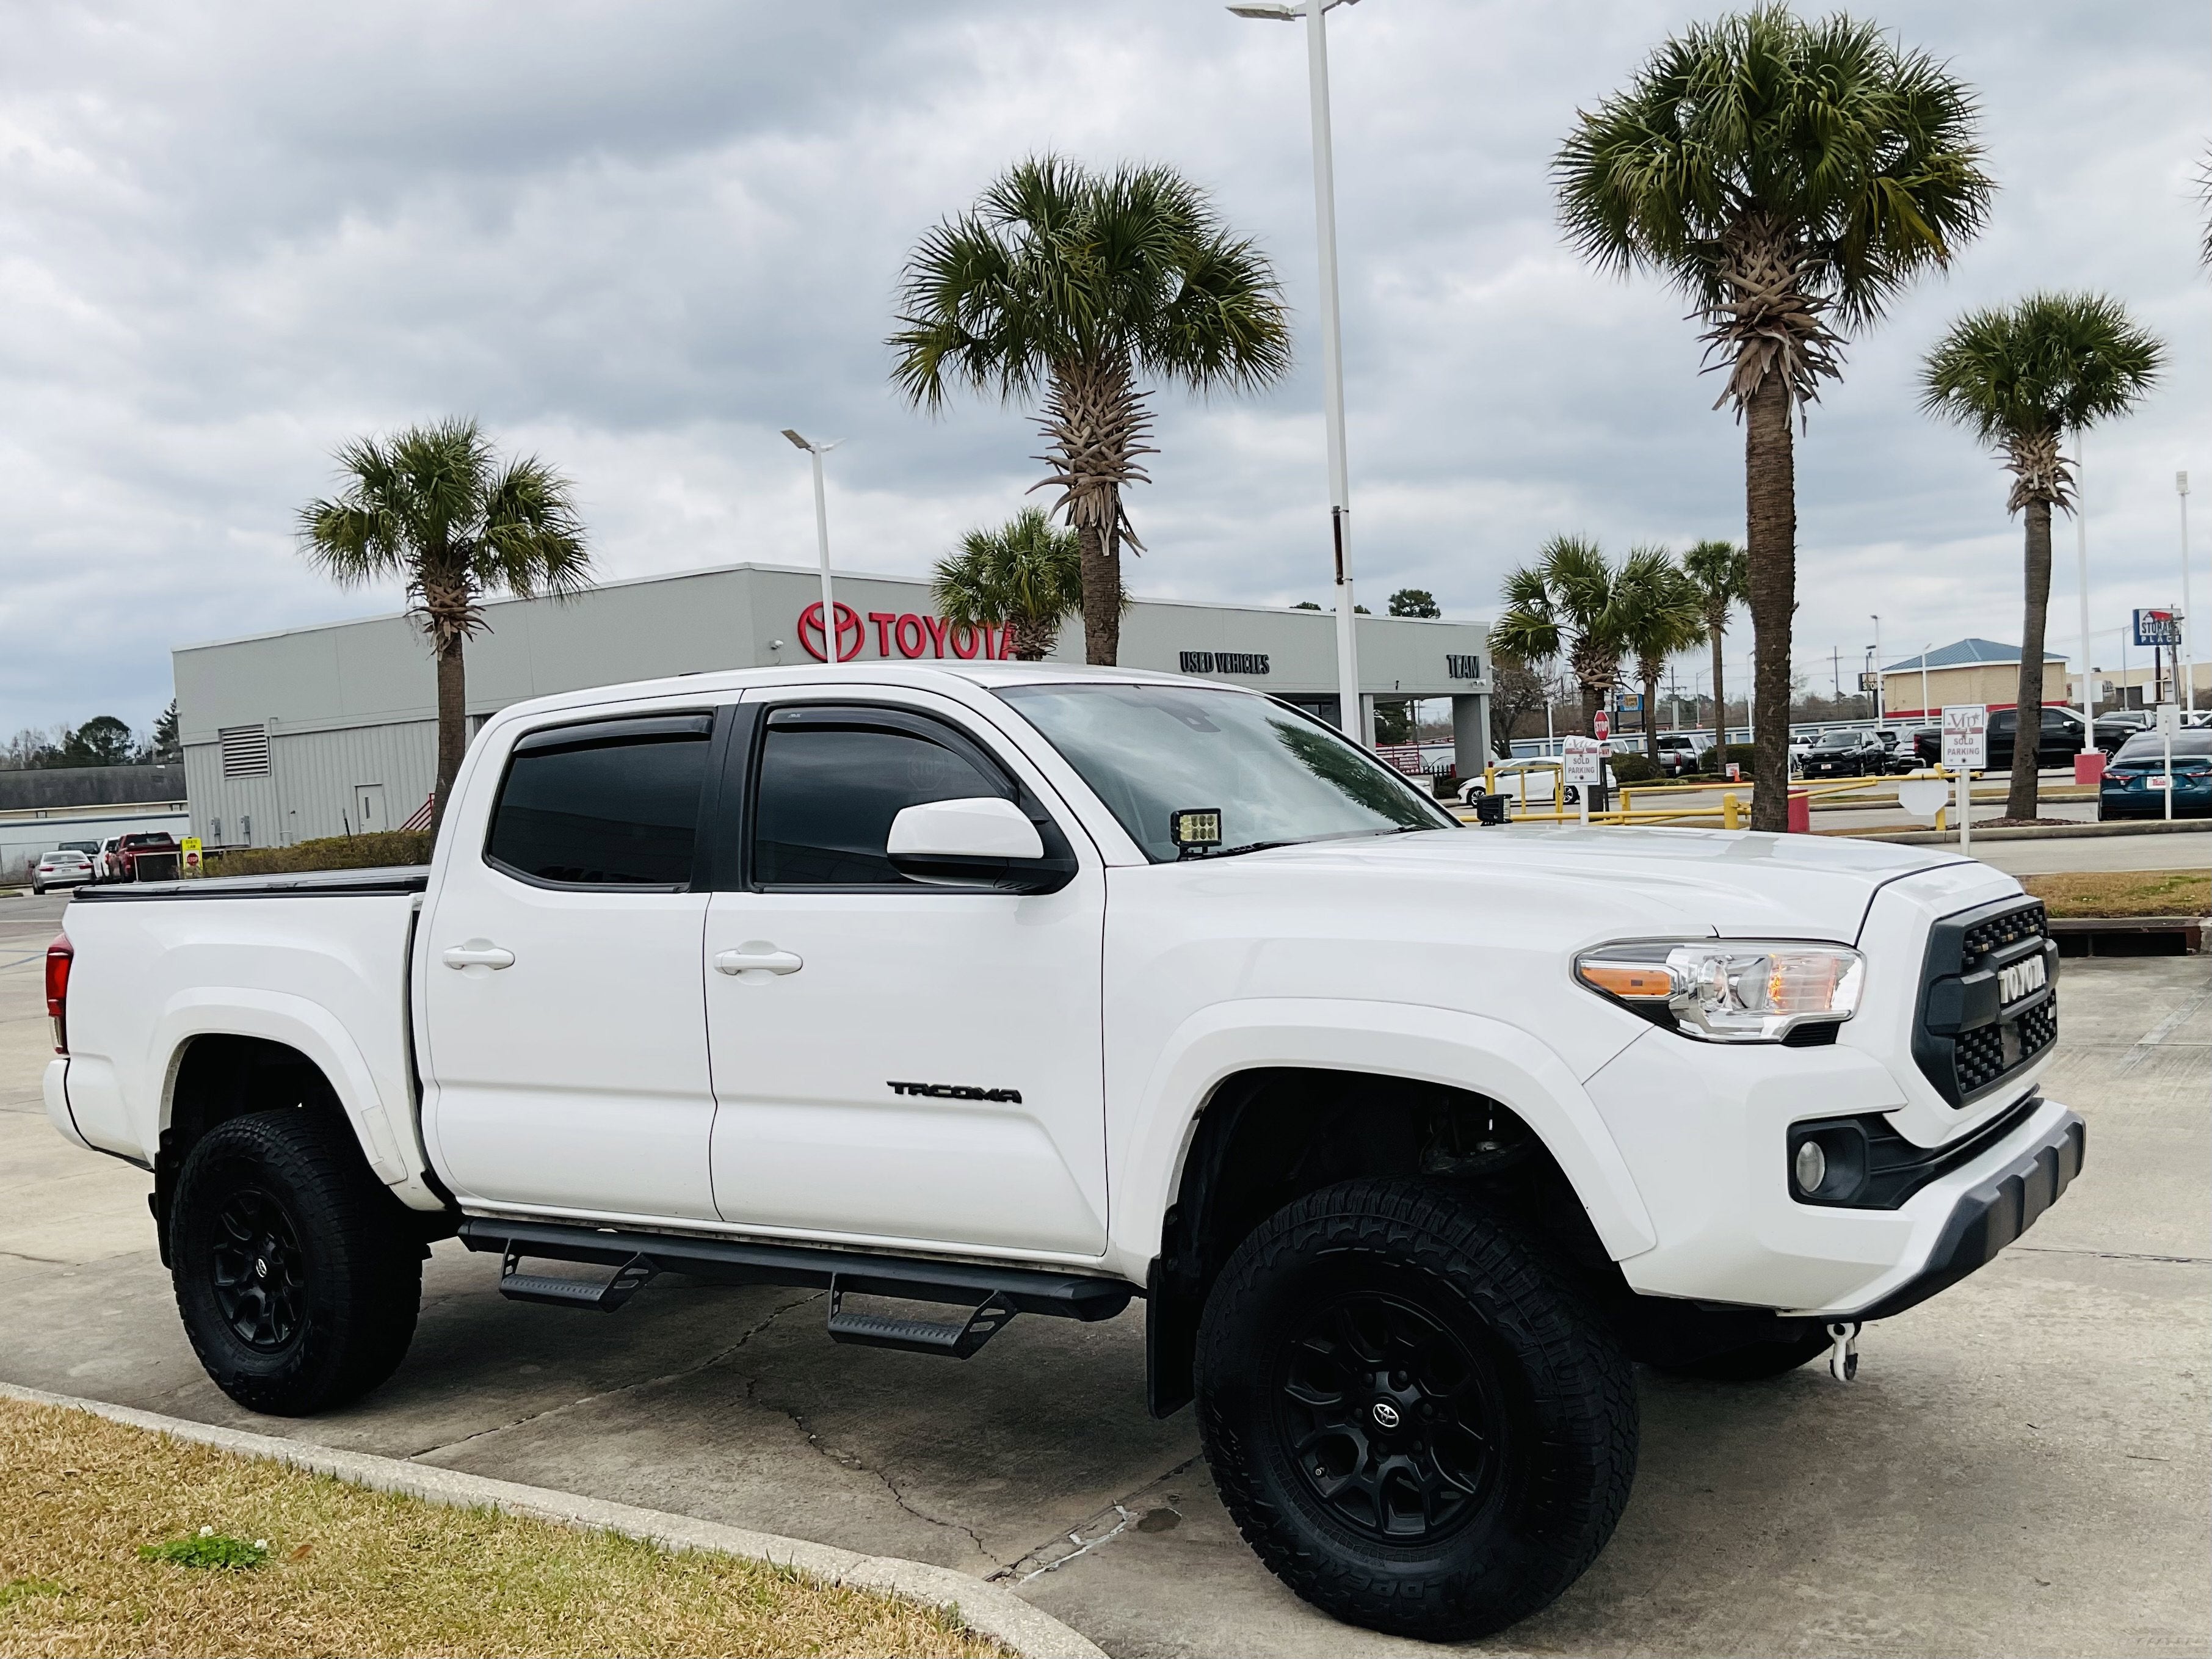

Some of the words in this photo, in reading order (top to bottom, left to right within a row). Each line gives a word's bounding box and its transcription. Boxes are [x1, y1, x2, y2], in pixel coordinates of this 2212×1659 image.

[1180, 652, 1214, 672] USED
[1215, 653, 1270, 674] VEHICLES
[1446, 655, 1480, 678] TEAM
[1595, 721, 1608, 732] STOP
[1998, 955, 2046, 1003] TOYOTA
[887, 1081, 1022, 1104] TACOMA
